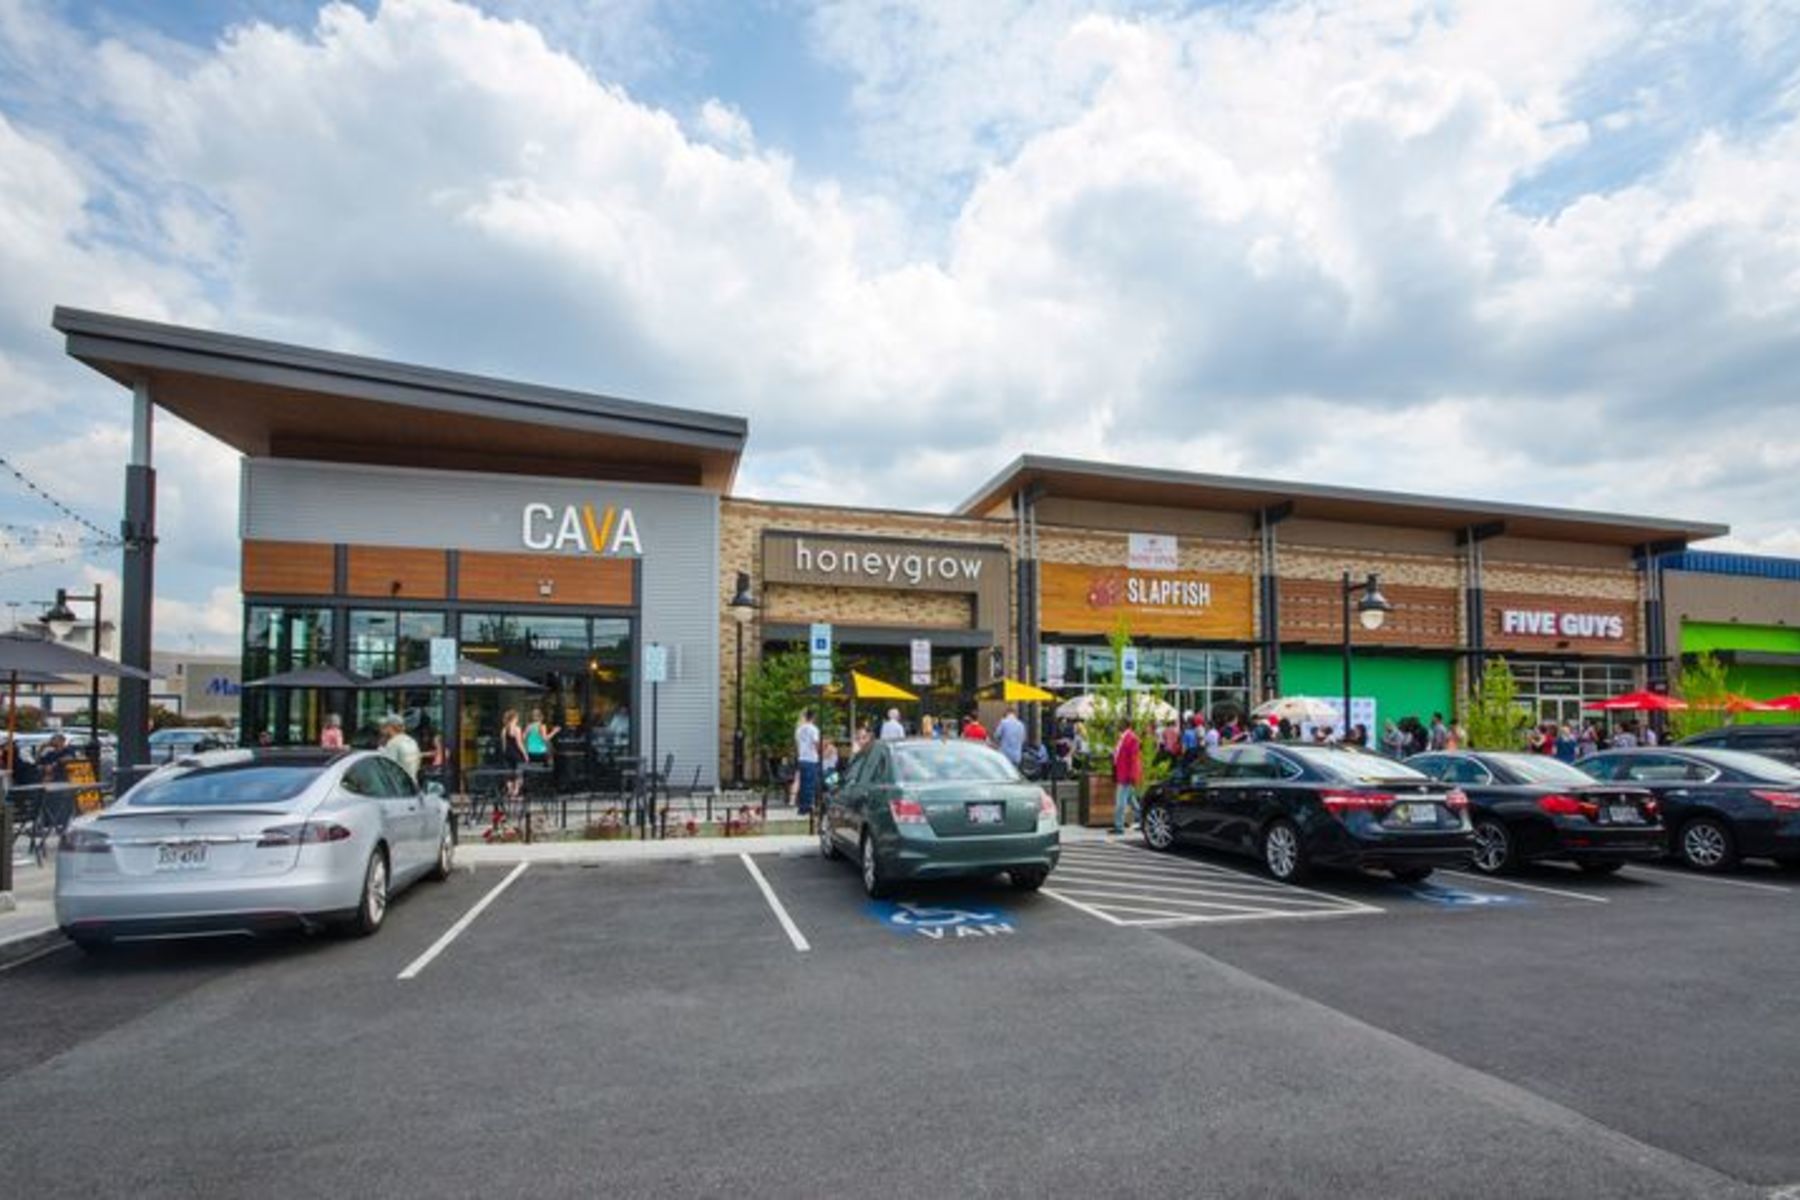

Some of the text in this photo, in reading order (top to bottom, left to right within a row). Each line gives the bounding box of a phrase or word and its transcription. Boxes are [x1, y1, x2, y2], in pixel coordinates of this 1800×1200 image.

[523, 502, 642, 554] CAVA
[796, 538, 982, 584] honeygrow
[1128, 577, 1211, 607] SLAPFISH
[1503, 610, 1623, 638] FIVE GUYS
[916, 923, 1016, 939] VAN
